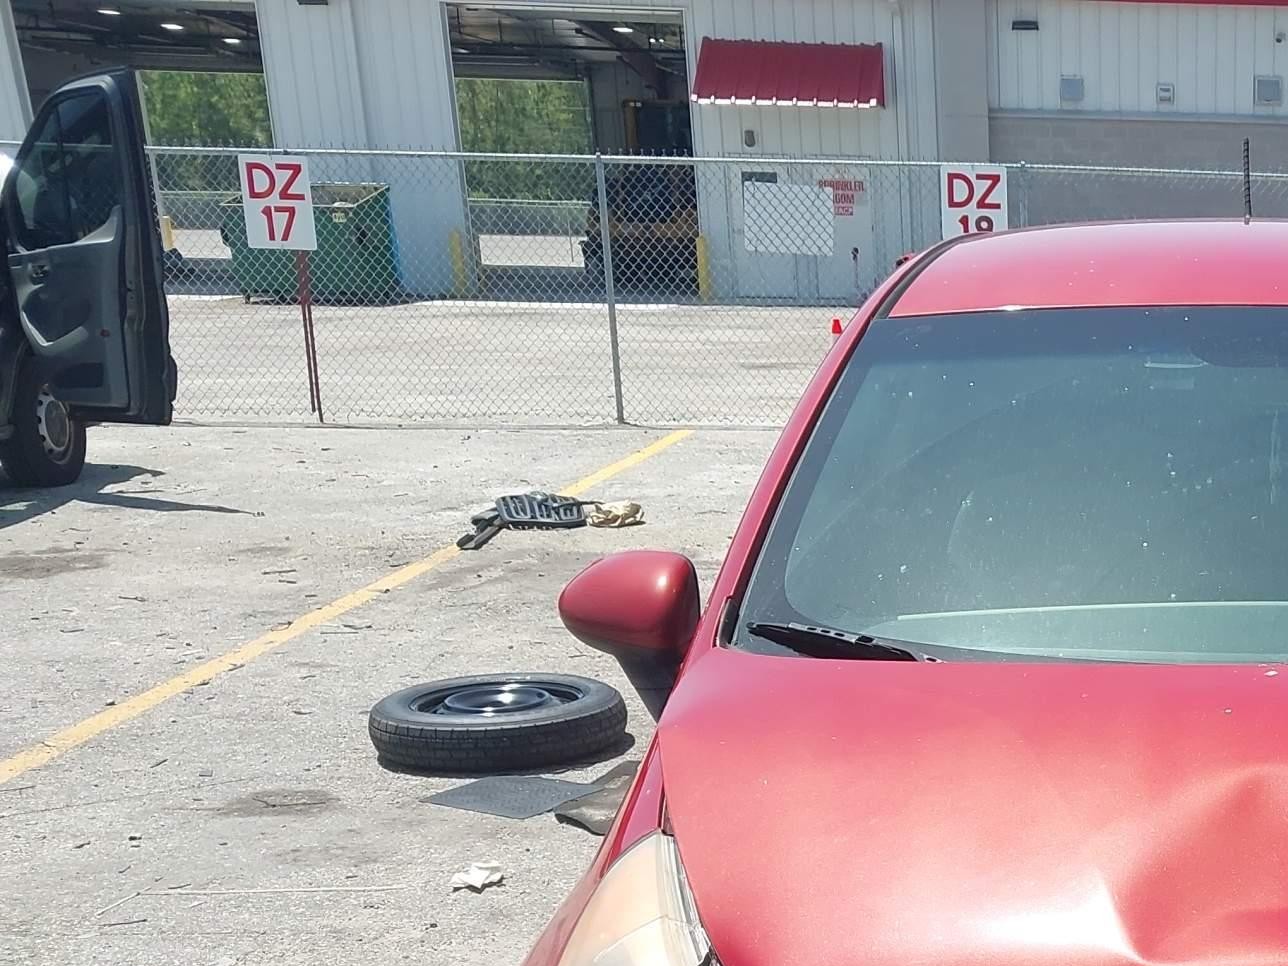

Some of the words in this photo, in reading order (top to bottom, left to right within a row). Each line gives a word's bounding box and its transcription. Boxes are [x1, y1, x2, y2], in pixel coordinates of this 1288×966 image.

[245, 161, 305, 201] DZ
[947, 172, 1001, 209] DZ
[261, 205, 296, 242] 17
